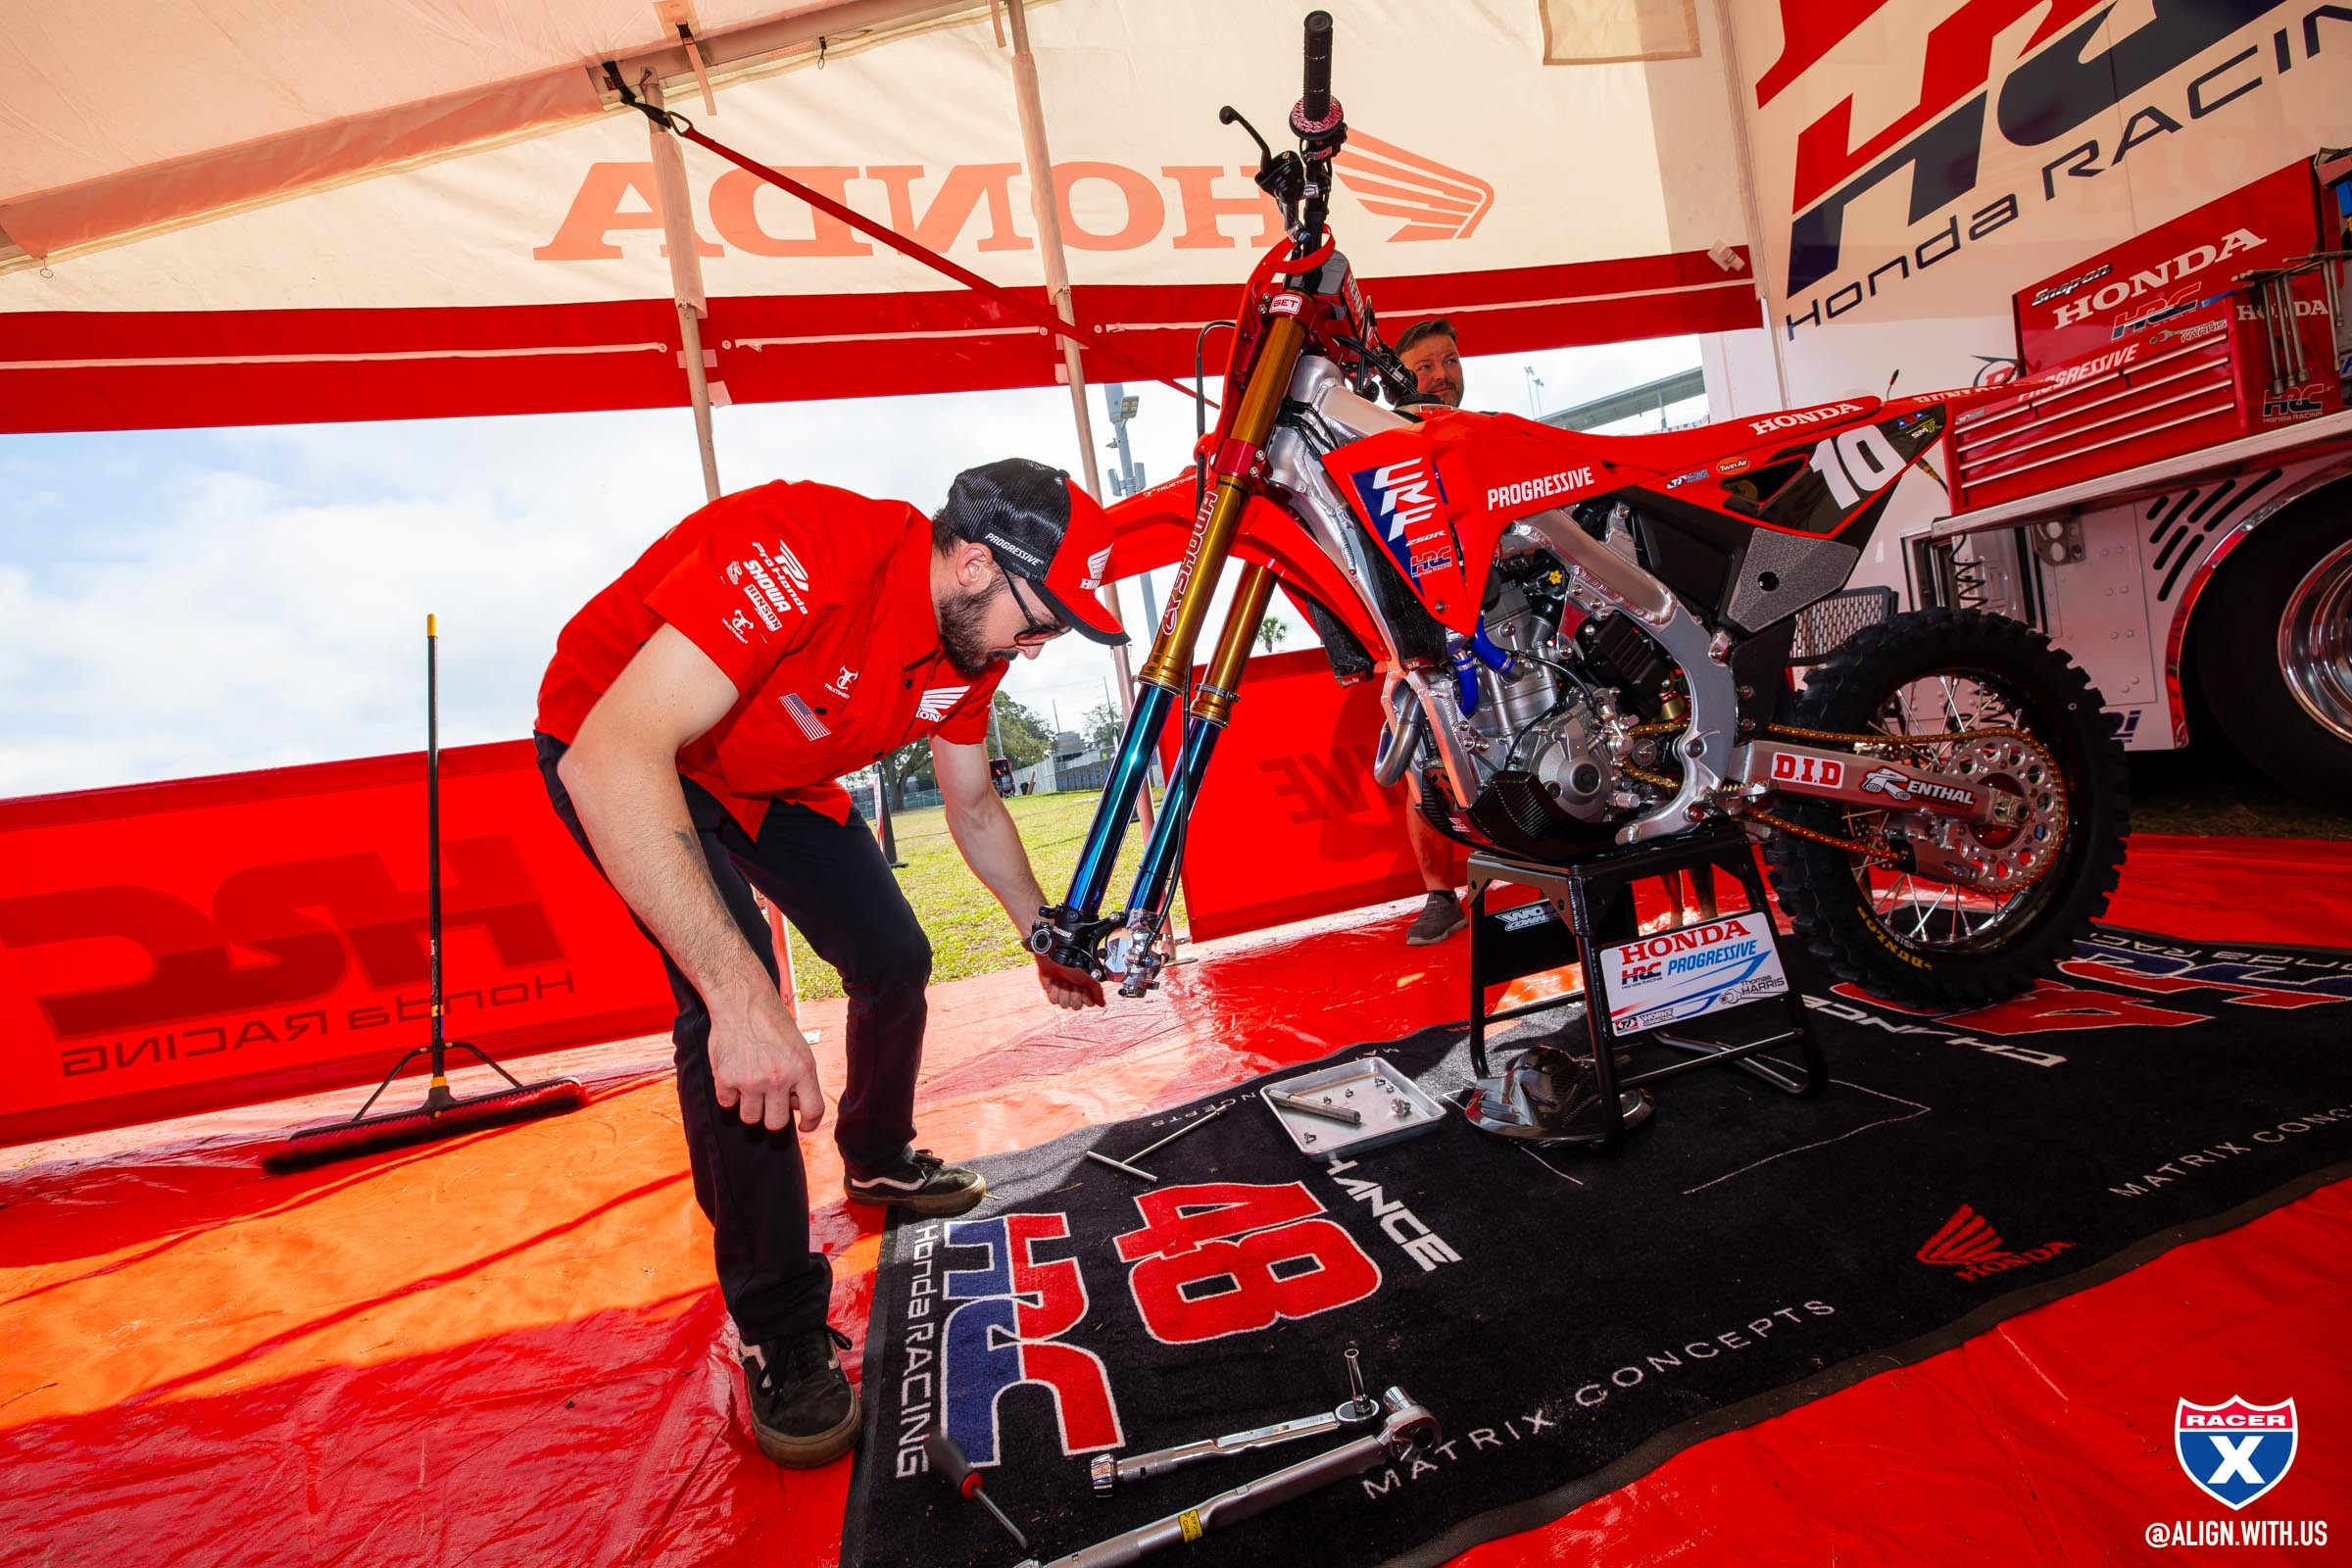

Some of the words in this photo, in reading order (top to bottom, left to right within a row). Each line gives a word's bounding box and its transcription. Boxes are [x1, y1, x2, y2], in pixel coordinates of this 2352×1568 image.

[1787, 193, 2019, 341] Honda
[2041, 4, 2352, 201] RACIN
[2052, 227, 2268, 330] HONDA
[2109, 281, 2202, 342] HRC
[2235, 300, 2329, 322] HODA
[1748, 403, 1865, 436] HONDA
[1487, 466, 1594, 512] PROGRESSIVE
[1719, 463, 1738, 473] Twin
[1808, 423, 1908, 511] 10
[1175, 490, 1219, 596] SHOWA
[1410, 545, 1452, 575] HRC
[742, 559, 792, 612] SHOWA
[751, 542, 775, 567] Pro
[771, 566, 809, 615] Honda
[746, 585, 782, 630] HINSON
[1774, 754, 1842, 785] D.I.D
[1619, 919, 1751, 965] HONDA
[1622, 960, 1663, 986] HRC
[1667, 939, 1757, 976] PROGRESSIVE
[1740, 977, 1786, 997] HARRIS
[2108, 1142, 2251, 1198] MATRIX
[2252, 1104, 2352, 1144] CONC
[907, 1224, 939, 1320] Honda
[1953, 1239, 2079, 1283] HONDA
[938, 1210, 1126, 1470] HRC
[896, 1322, 935, 1479] RACING
[1361, 1408, 1555, 1499] MATRIX
[1574, 1298, 1836, 1408] CONCEPTS
